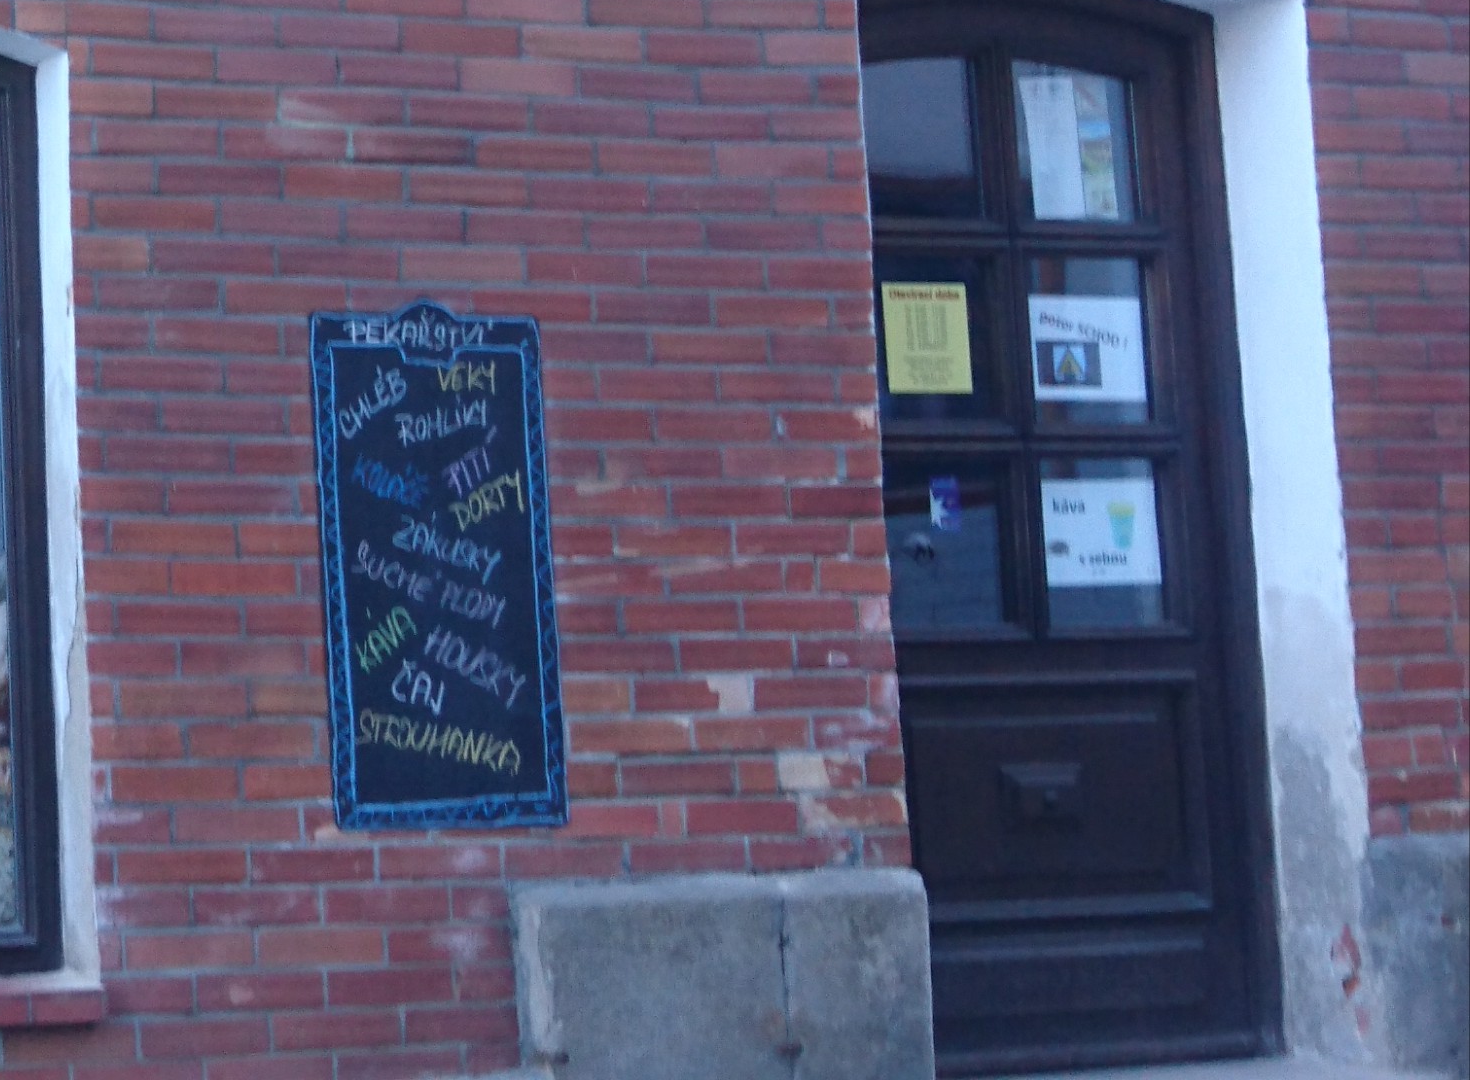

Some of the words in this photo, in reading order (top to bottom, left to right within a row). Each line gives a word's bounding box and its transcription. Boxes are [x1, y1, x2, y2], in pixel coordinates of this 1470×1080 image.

[449, 468, 524, 533] DORTY
[391, 657, 445, 716] ČAJ
[357, 708, 521, 777] STROUHANKA
